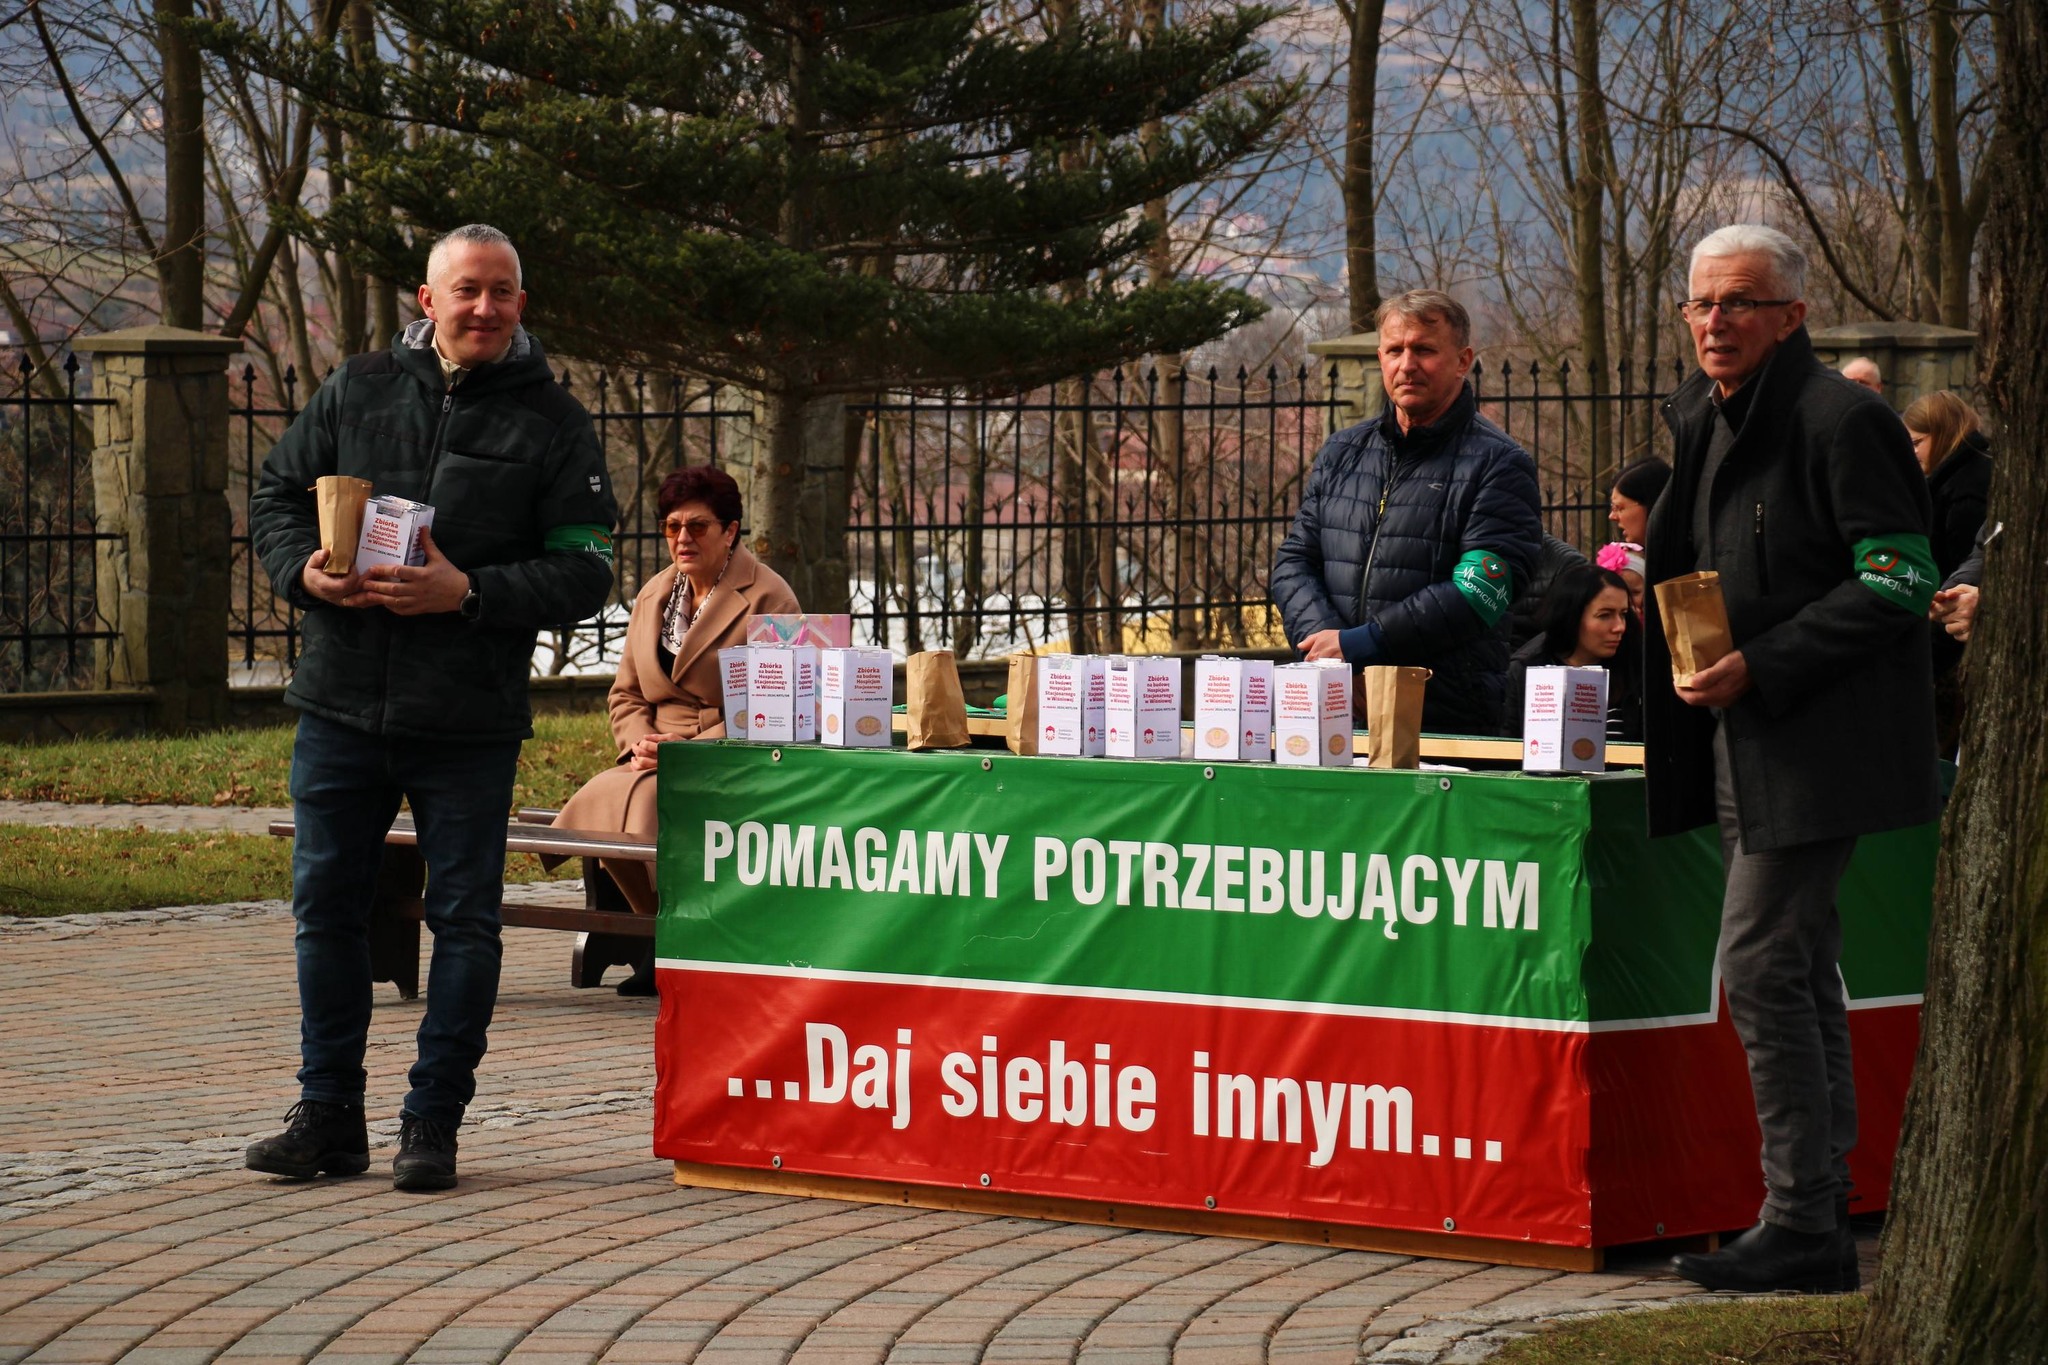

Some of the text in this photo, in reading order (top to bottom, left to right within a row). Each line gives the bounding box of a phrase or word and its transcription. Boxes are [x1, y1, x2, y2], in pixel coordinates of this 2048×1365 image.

[375, 518, 398, 528] Zbiórka
[367, 533, 401, 545] Stacjonarnego
[372, 529, 397, 539] Hospicjum
[704, 820, 1540, 940] POMAGAMY POTRZEBUJĄCYM
[940, 1035, 1157, 1132] siebie
